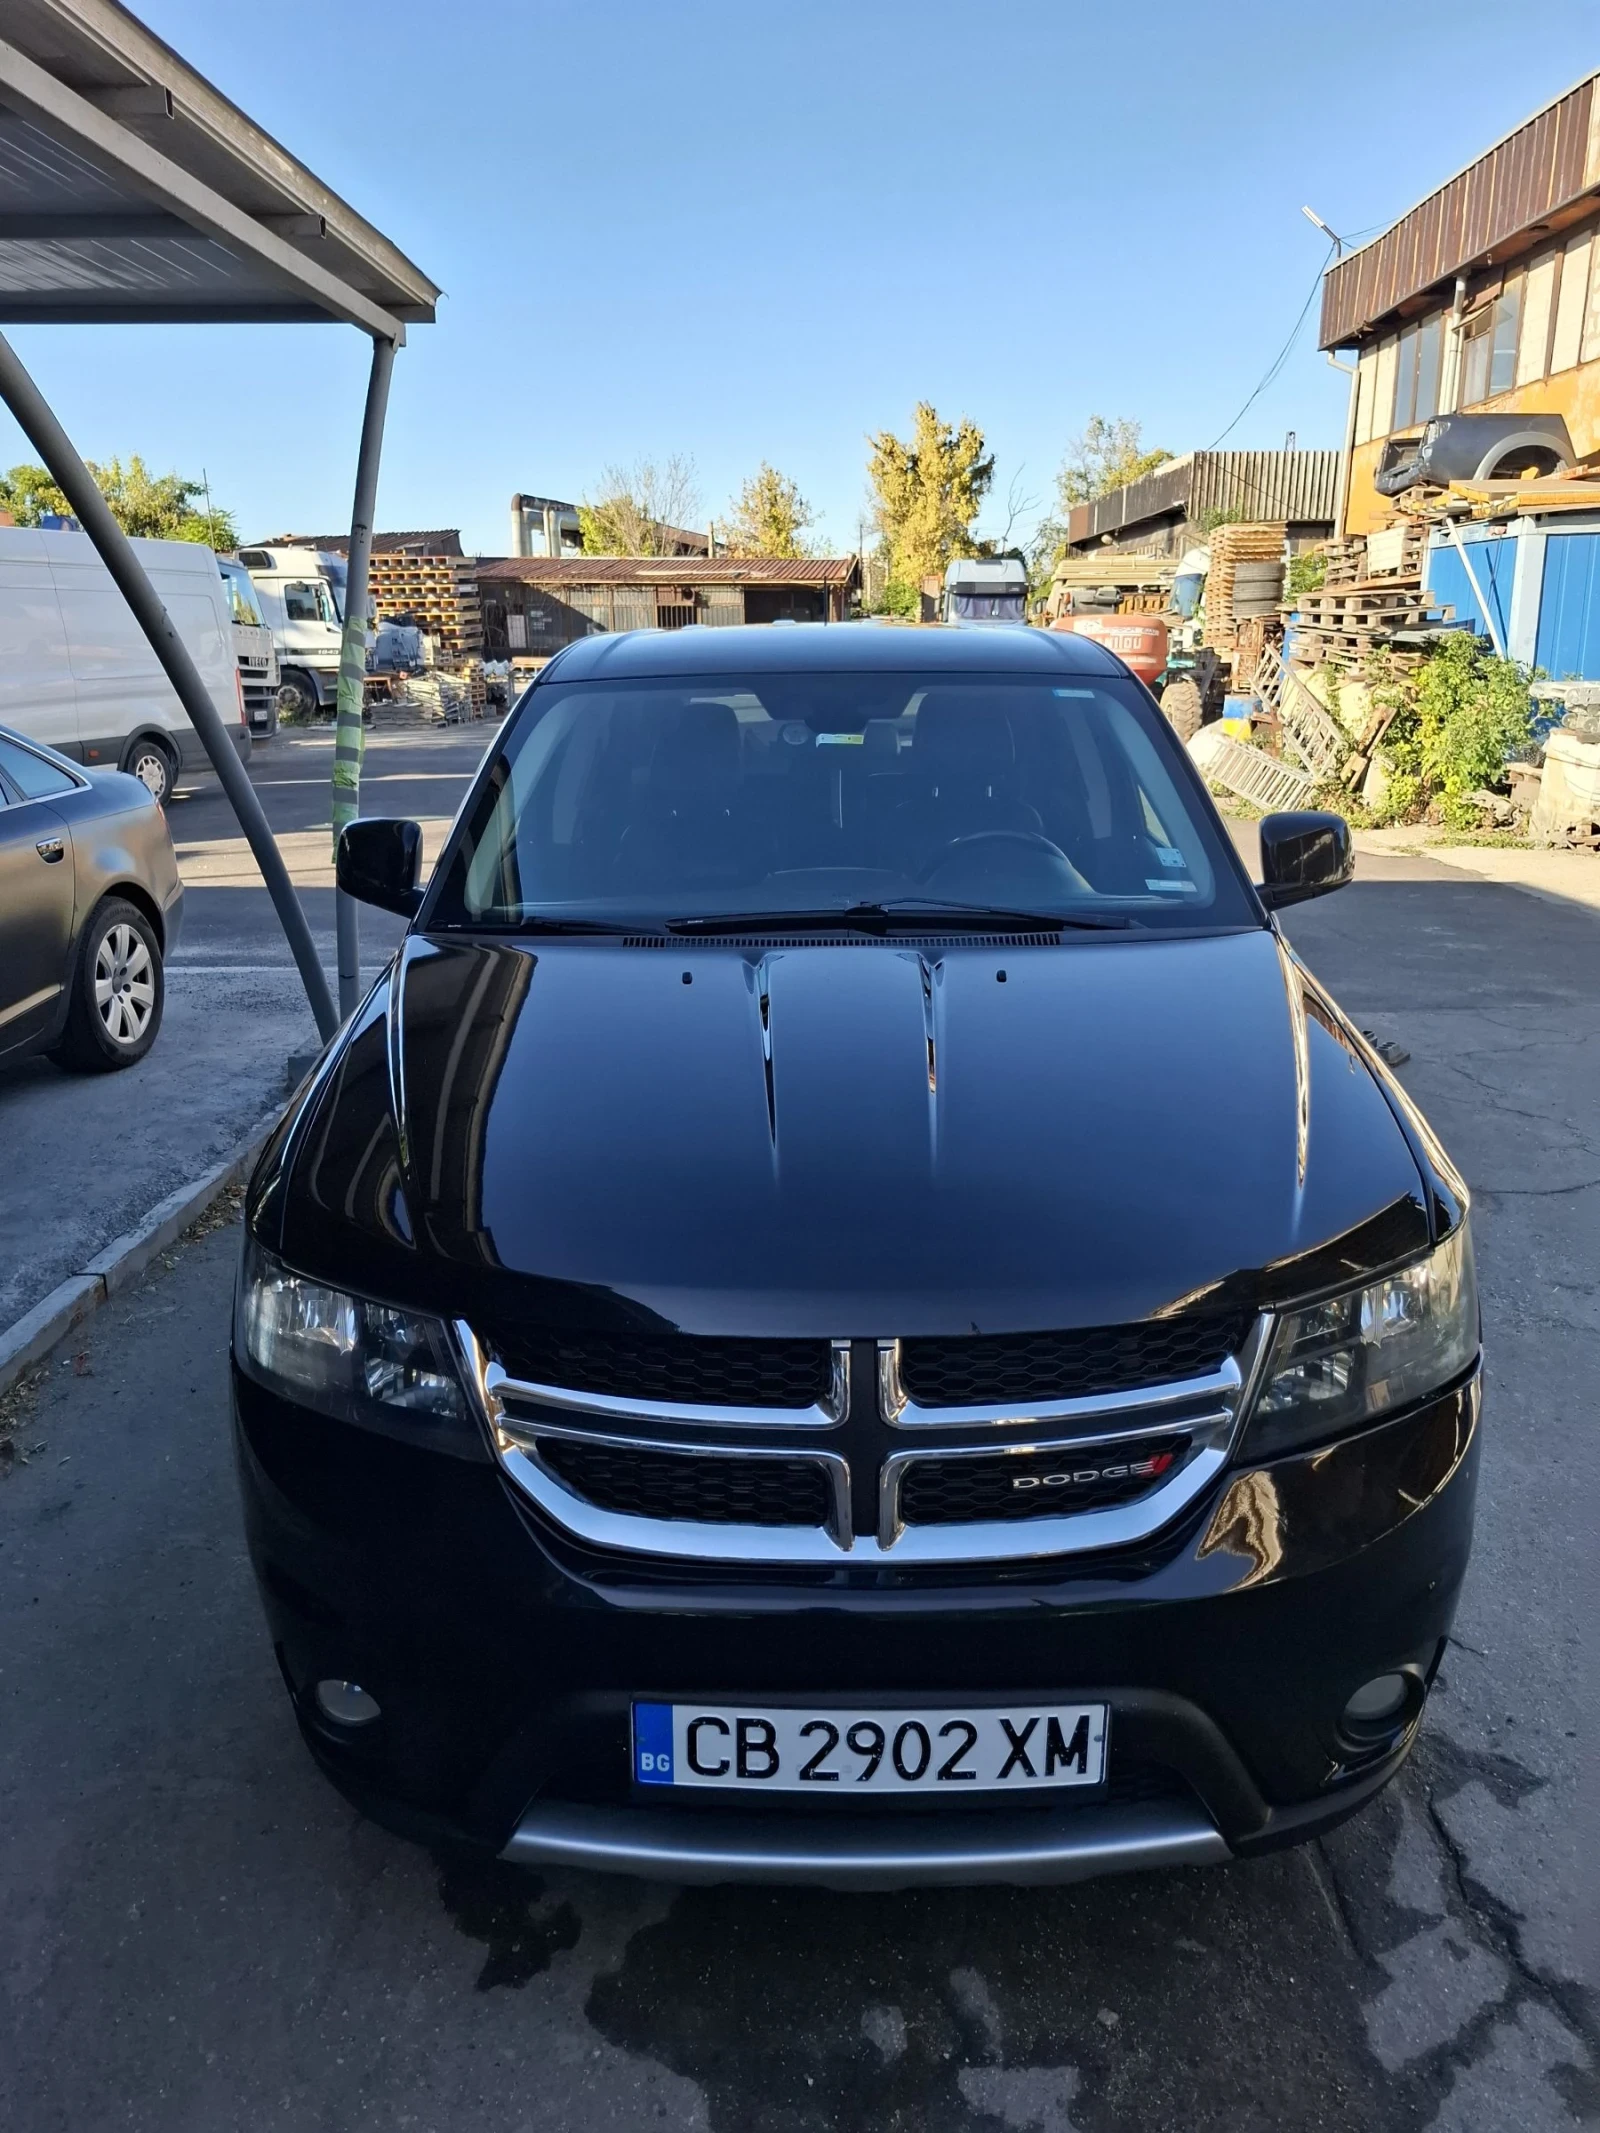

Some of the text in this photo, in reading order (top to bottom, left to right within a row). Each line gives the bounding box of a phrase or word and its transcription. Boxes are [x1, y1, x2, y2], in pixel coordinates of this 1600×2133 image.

[1013, 1460, 1154, 1489] DODGE
[640, 1753, 670, 1772] BG
[686, 1714, 1092, 1782] CB 2902 XM
